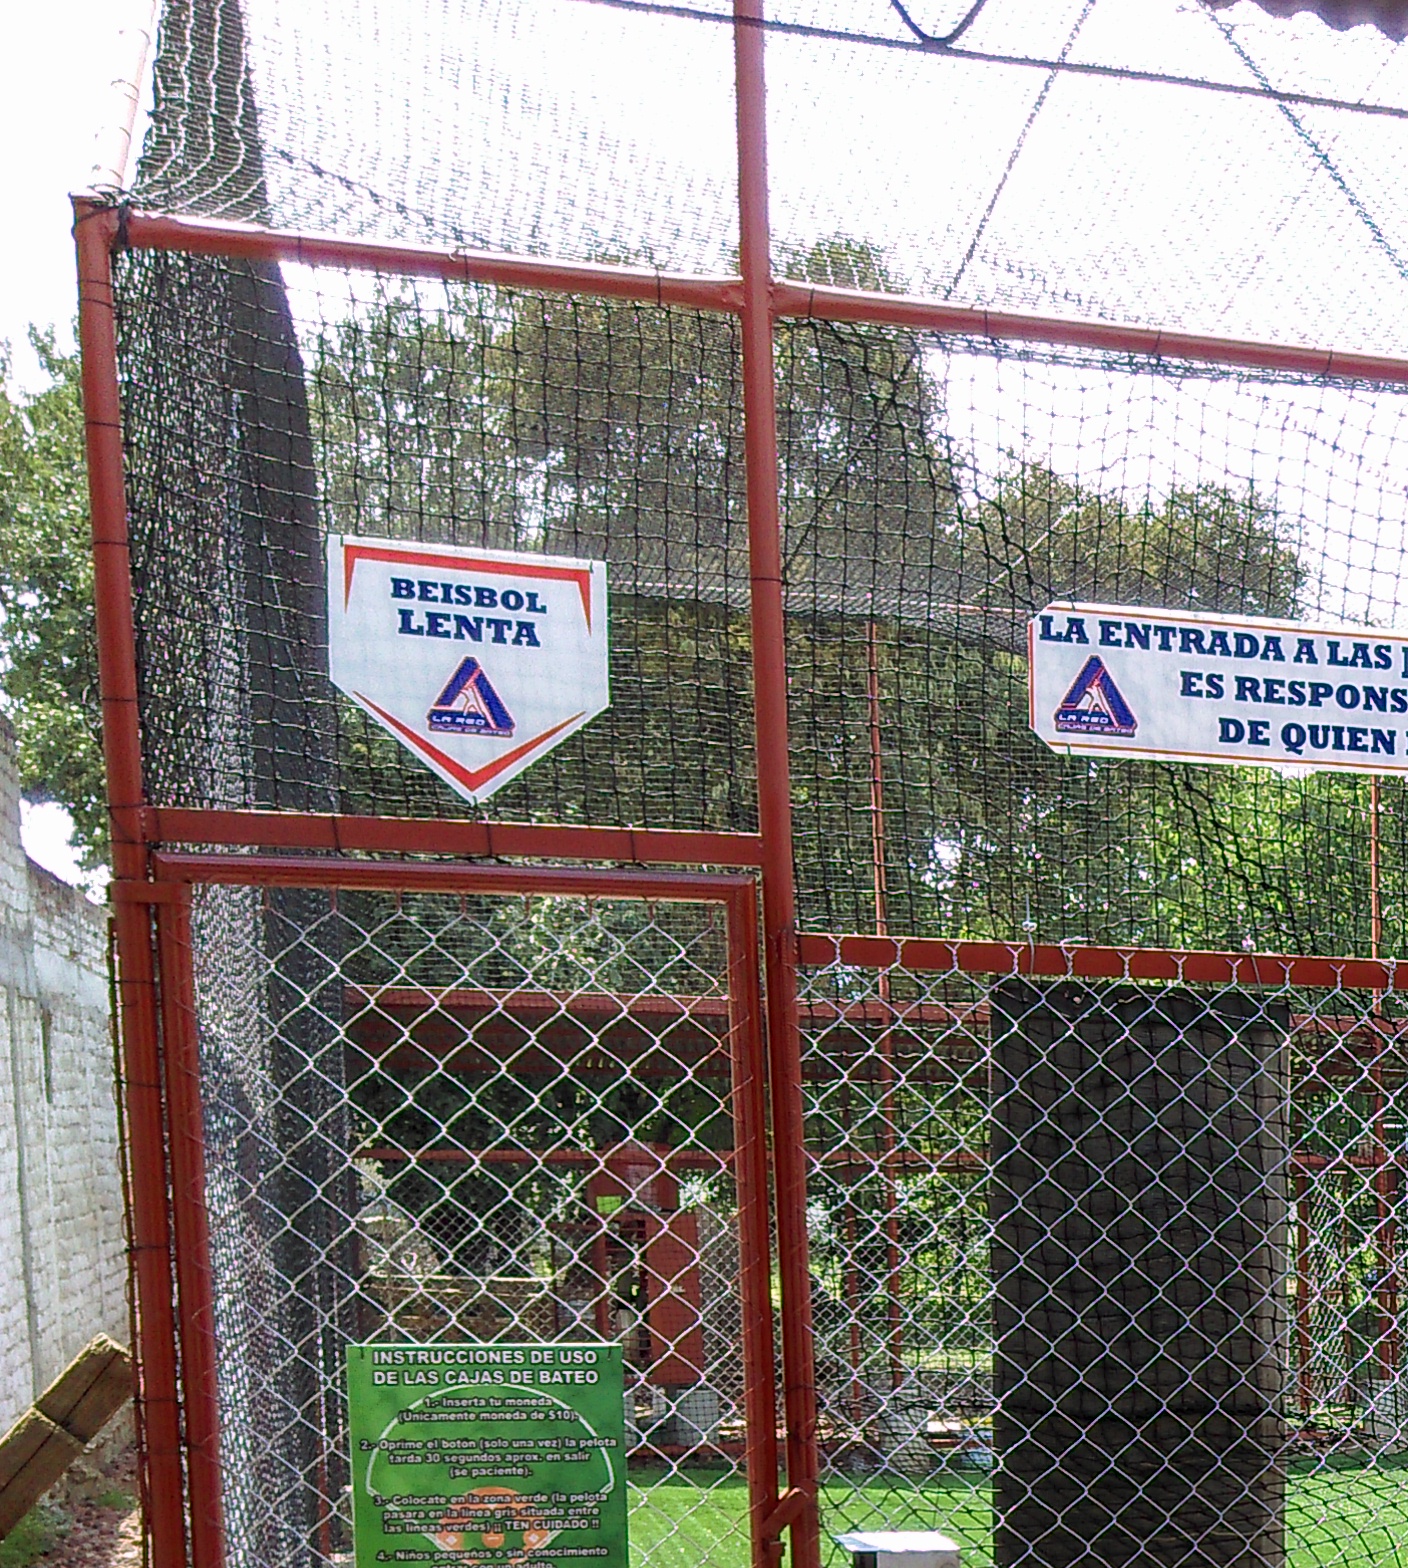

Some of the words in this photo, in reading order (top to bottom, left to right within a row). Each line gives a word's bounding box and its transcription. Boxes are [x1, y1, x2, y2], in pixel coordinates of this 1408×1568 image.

[390, 577, 547, 614] BEISBOL
[398, 608, 541, 648] LENTA
[1039, 614, 1090, 645] LA
[1098, 619, 1286, 663] ENTRADA
[1293, 638, 1319, 665] A
[1326, 640, 1392, 670] LAS
[1179, 671, 1225, 700] ES
[432, 715, 452, 723] LA
[1081, 716, 1109, 724] RED
[1218, 718, 1271, 746] DE
[1281, 722, 1396, 756] QUIEN
[373, 1351, 524, 1364] INSTRUCCIONES
[530, 1351, 554, 1364] DE
[560, 1351, 597, 1364] USO
[373, 1371, 398, 1385] DE
[404, 1371, 439, 1384] LAS
[445, 1370, 504, 1384] CAJAS
[510, 1371, 533, 1384] DE
[540, 1371, 598, 1384] BATEO
[443, 1398, 486, 1407] Inserta
[490, 1398, 501, 1406] tu
[505, 1398, 553, 1406] moneda
[479, 1411, 527, 1420] moneda
[530, 1411, 545, 1420] de
[380, 1440, 423, 1451] Oprime
[426, 1439, 437, 1449] el
[512, 1440, 534, 1448] una
[538, 1438, 561, 1449] vez)
[565, 1438, 576, 1447] la
[580, 1438, 616, 1449] pelota
[389, 1454, 422, 1463] tarda
[426, 1453, 440, 1463] 30
[444, 1453, 501, 1464] segundos
[505, 1453, 542, 1463] aprox.
[546, 1453, 560, 1461] en
[564, 1451, 591, 1461] salir
[450, 1467, 468, 1478] (se
[472, 1466, 532, 1477] paciente).
[392, 1495, 446, 1505] Colocate
[451, 1496, 465, 1504] en
[469, 1495, 480, 1504] la
[484, 1495, 511, 1503] zona
[515, 1493, 548, 1502] verde
[570, 1492, 607, 1504] pelota
[383, 1511, 425, 1520] pasara
[428, 1510, 443, 1519] en
[447, 1509, 458, 1518] la
[494, 1507, 517, 1519] gris
[520, 1507, 564, 1516] situada
[568, 1507, 599, 1516] entre
[384, 1523, 402, 1532] las
[445, 1522, 490, 1532] verdes)
[505, 1521, 529, 1530] TEN
[533, 1520, 588, 1530] CUIDADO
[495, 1550, 503, 1558] o
[506, 1549, 523, 1558] sin
[527, 1548, 608, 1558] conocimiento
